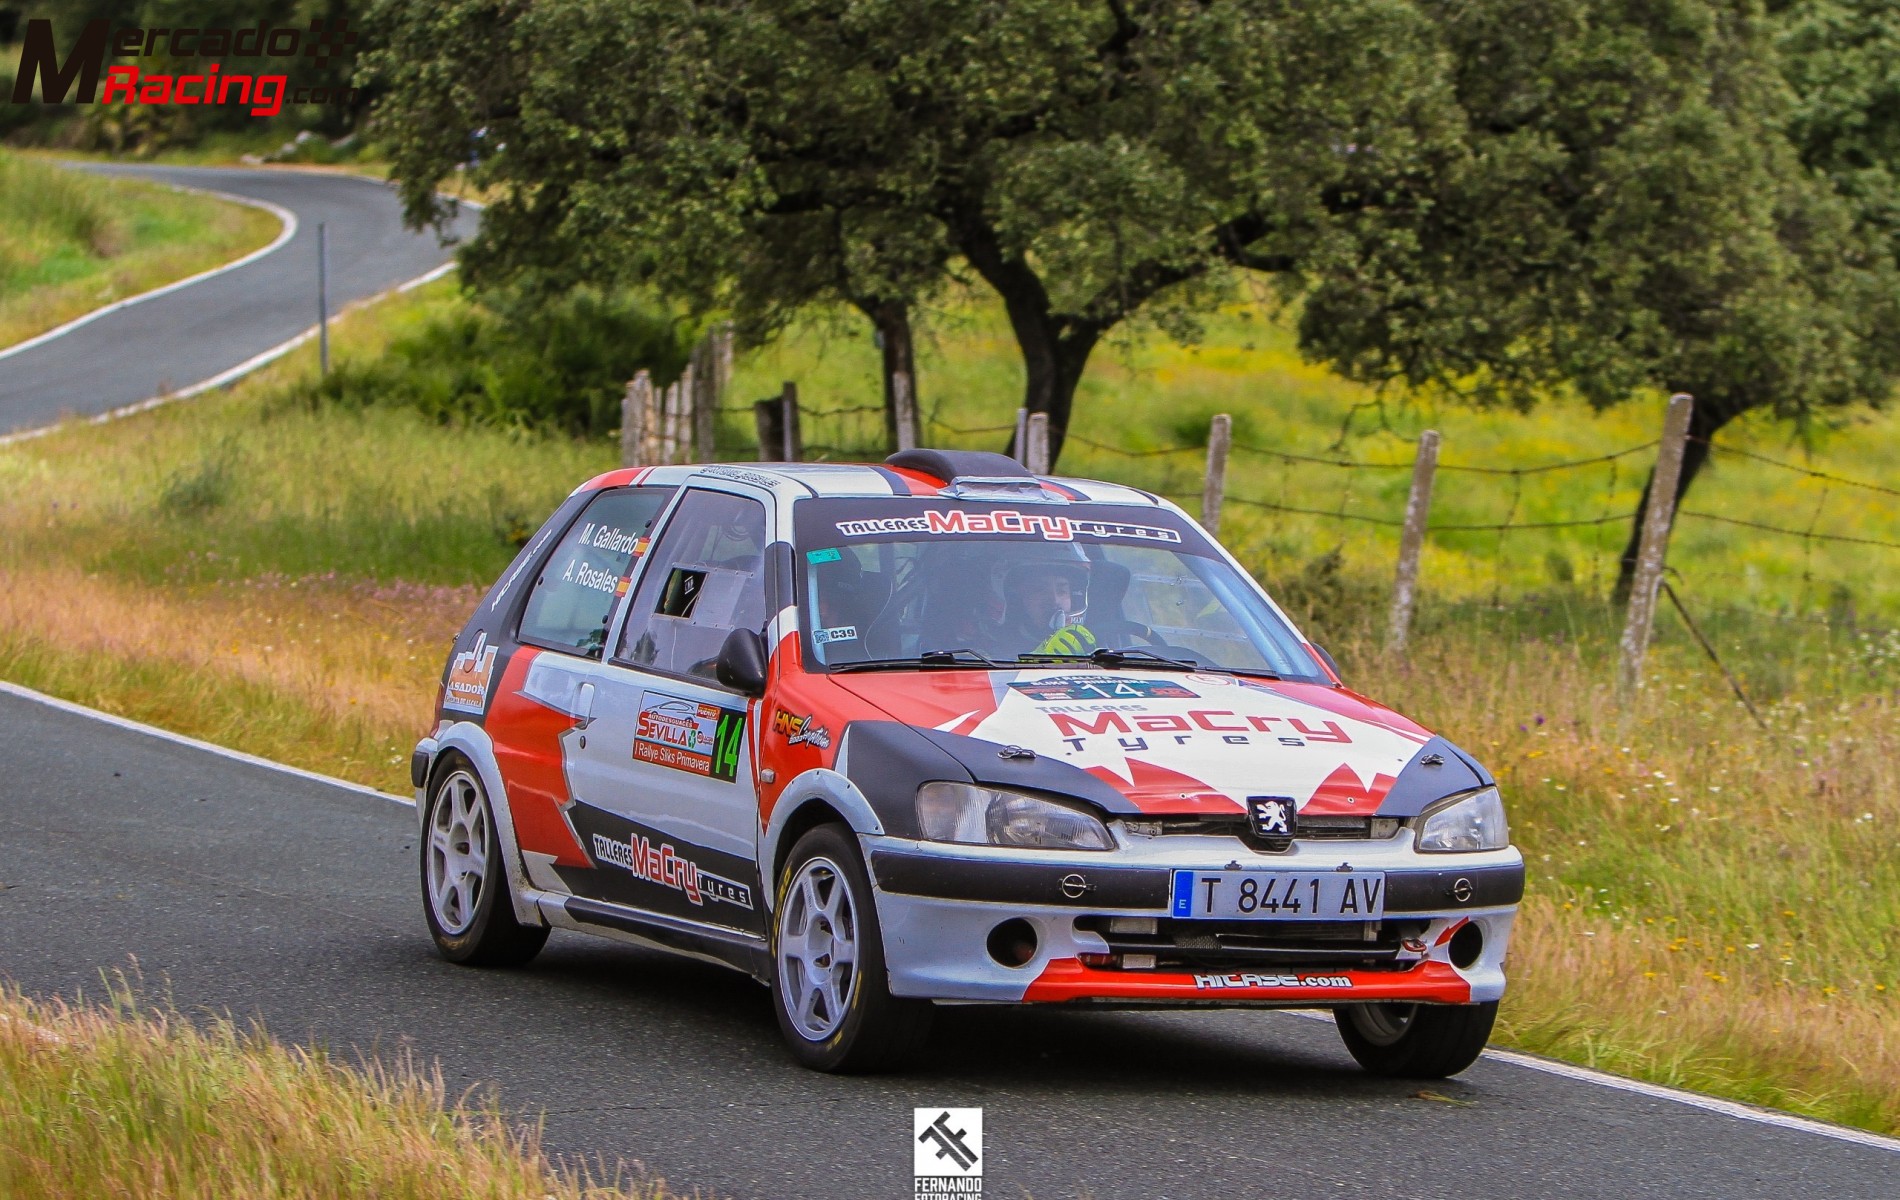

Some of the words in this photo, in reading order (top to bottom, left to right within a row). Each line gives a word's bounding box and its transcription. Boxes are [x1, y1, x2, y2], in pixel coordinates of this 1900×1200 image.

[578, 523, 595, 545] M.
[593, 525, 639, 555] Gallardo
[839, 522, 931, 535] TALLERES
[927, 511, 1074, 540] MaCry
[562, 559, 576, 582] A.
[576, 562, 618, 594] Rosales
[830, 629, 856, 639] C39
[449, 682, 485, 695] ASADOR
[1081, 684, 1145, 698] 14
[774, 710, 803, 736] HNS
[1036, 705, 1149, 713] TALLERES
[637, 711, 688, 747] SEVILLA
[1048, 710, 1353, 743] MaCry
[640, 742, 659, 762] Rallye
[660, 747, 675, 764] Sliks
[676, 752, 710, 772] Primavera
[716, 714, 743, 777] 14
[1063, 736, 1305, 751] Tyres
[594, 836, 633, 866] TALLERES
[631, 833, 703, 906] MaCry
[1178, 899, 1187, 909] E
[1201, 878, 1221, 912] T
[1238, 878, 1320, 913] 8441
[1339, 878, 1381, 914] AV
